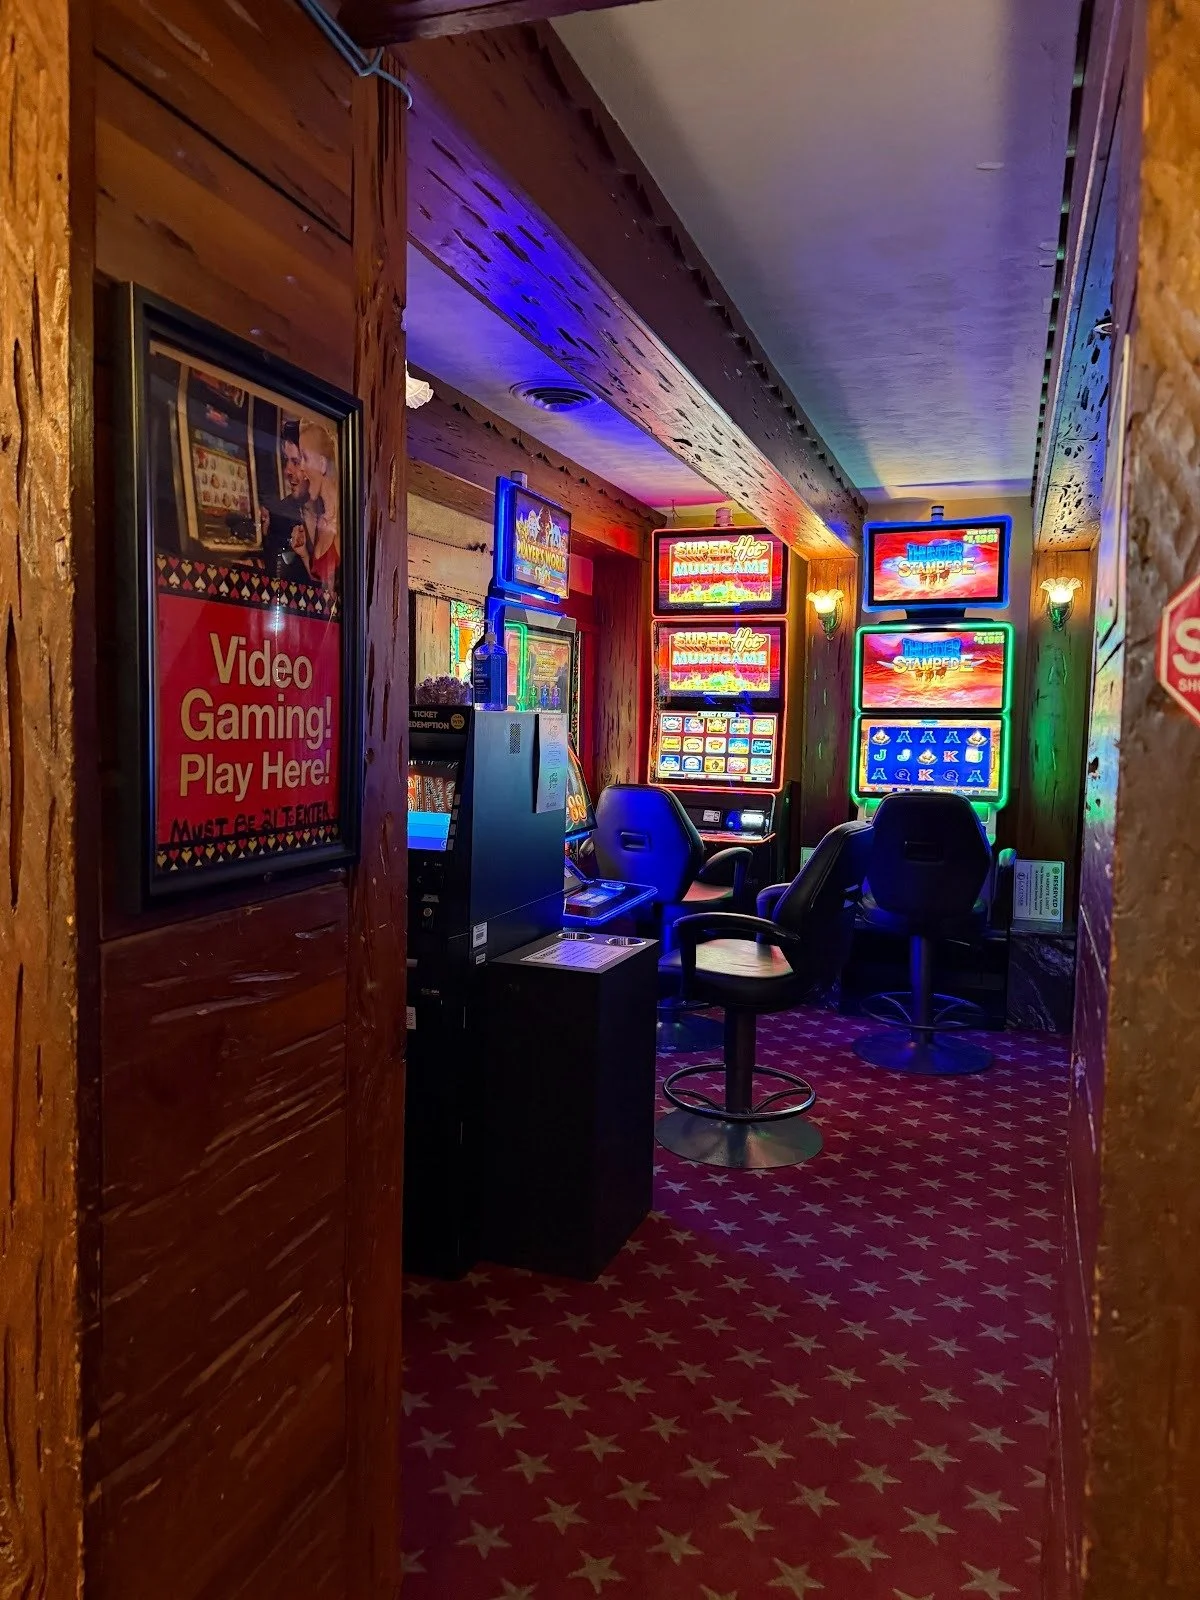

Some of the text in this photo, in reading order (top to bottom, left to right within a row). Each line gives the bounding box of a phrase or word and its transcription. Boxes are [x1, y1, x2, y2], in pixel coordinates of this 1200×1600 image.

[675, 535, 768, 562] SUPER Hot
[907, 542, 963, 560] THUNDER
[545, 550, 566, 573] WORLD
[898, 557, 976, 578] STAMPEDE
[675, 628, 766, 652] SUPER Hot
[903, 638, 962, 657] THUNDER
[209, 632, 313, 690] Video
[893, 654, 974, 674] STAMPEDE
[180, 688, 332, 750] Gaming!
[408, 720, 450, 730] EDEMPTION
[413, 710, 438, 719] TICKET
[179, 749, 331, 802] Play Here!
[170, 816, 228, 845] MUST
[234, 813, 255, 836] BE
[296, 800, 329, 825] ENTER
